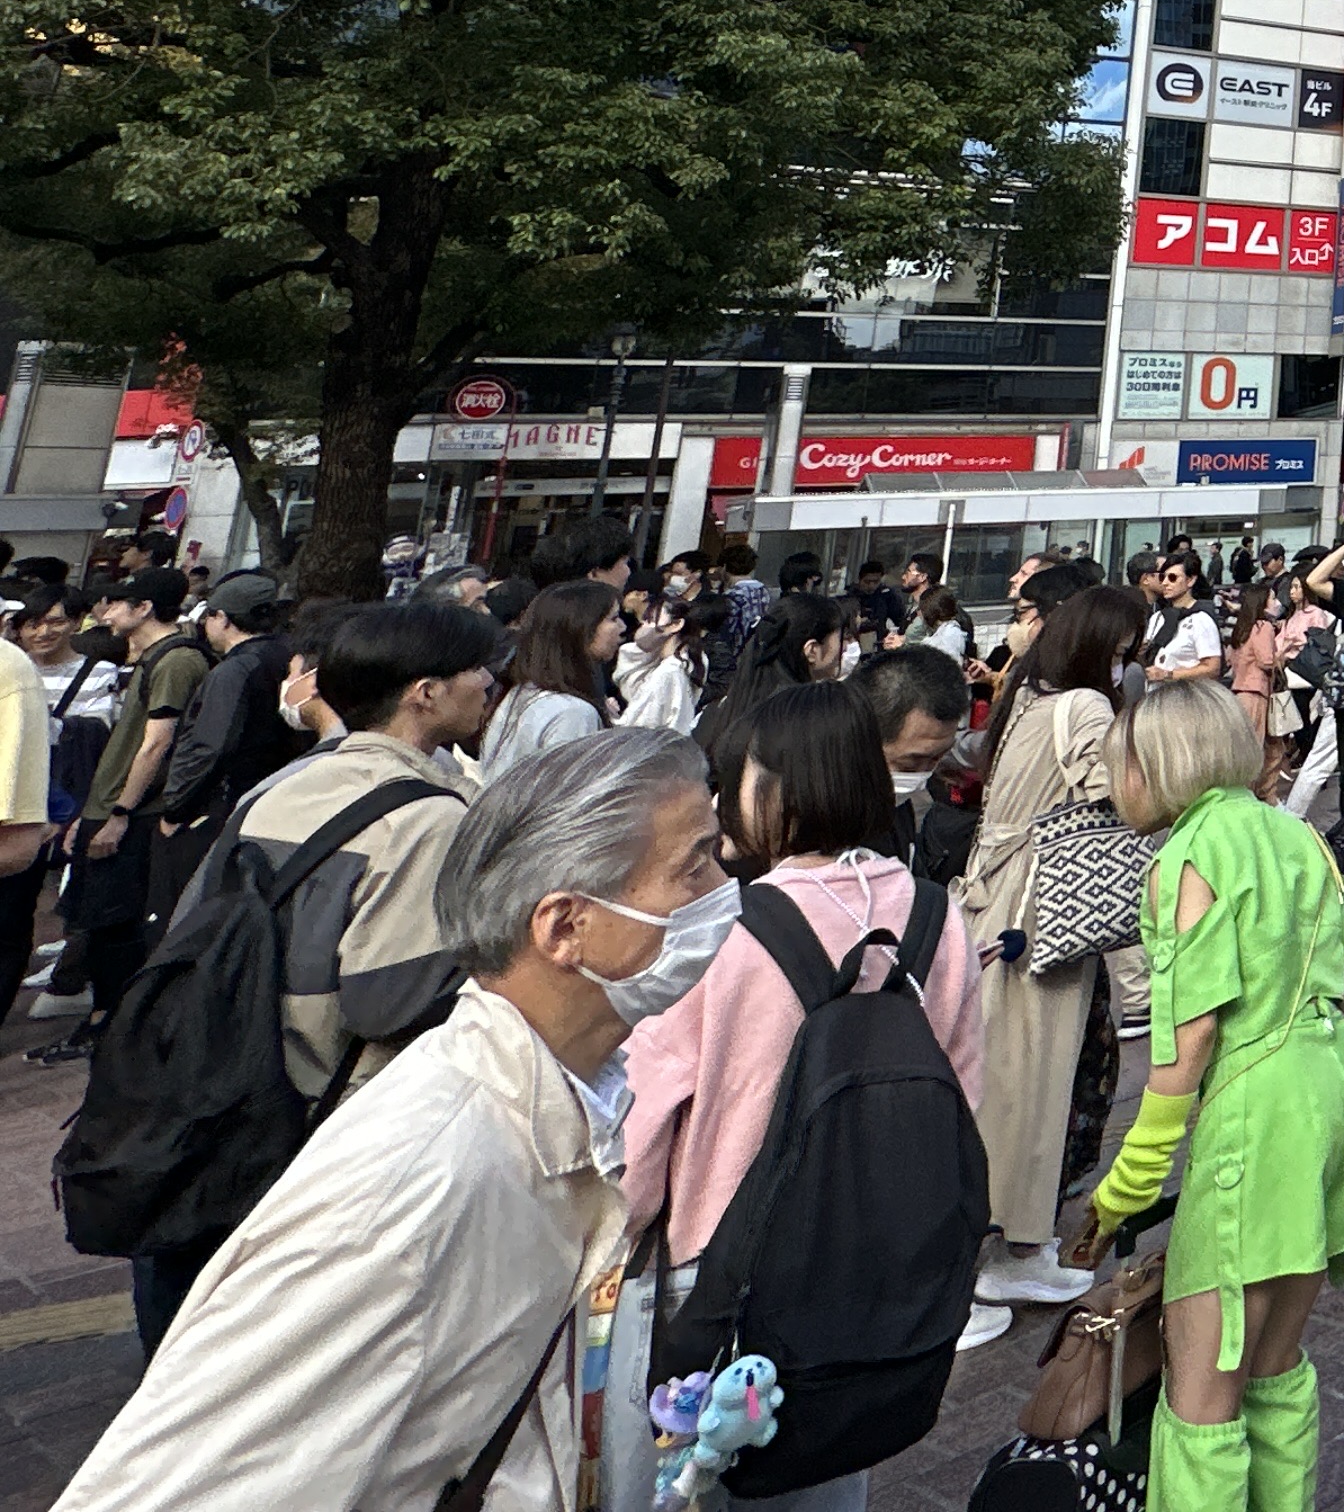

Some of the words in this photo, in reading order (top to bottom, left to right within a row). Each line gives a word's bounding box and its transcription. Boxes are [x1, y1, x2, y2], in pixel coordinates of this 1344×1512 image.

[1219, 76, 1290, 98] EAST
[1303, 92, 1333, 118] 4F
[1156, 213, 1280, 255] アコム
[1299, 216, 1330, 237] 3F
[1289, 247, 1319, 266] 入口
[460, 392, 502, 409] 消火栓
[799, 442, 872, 478] Cozy
[870, 444, 953, 469] Corner
[1189, 452, 1272, 472] PROMISE
